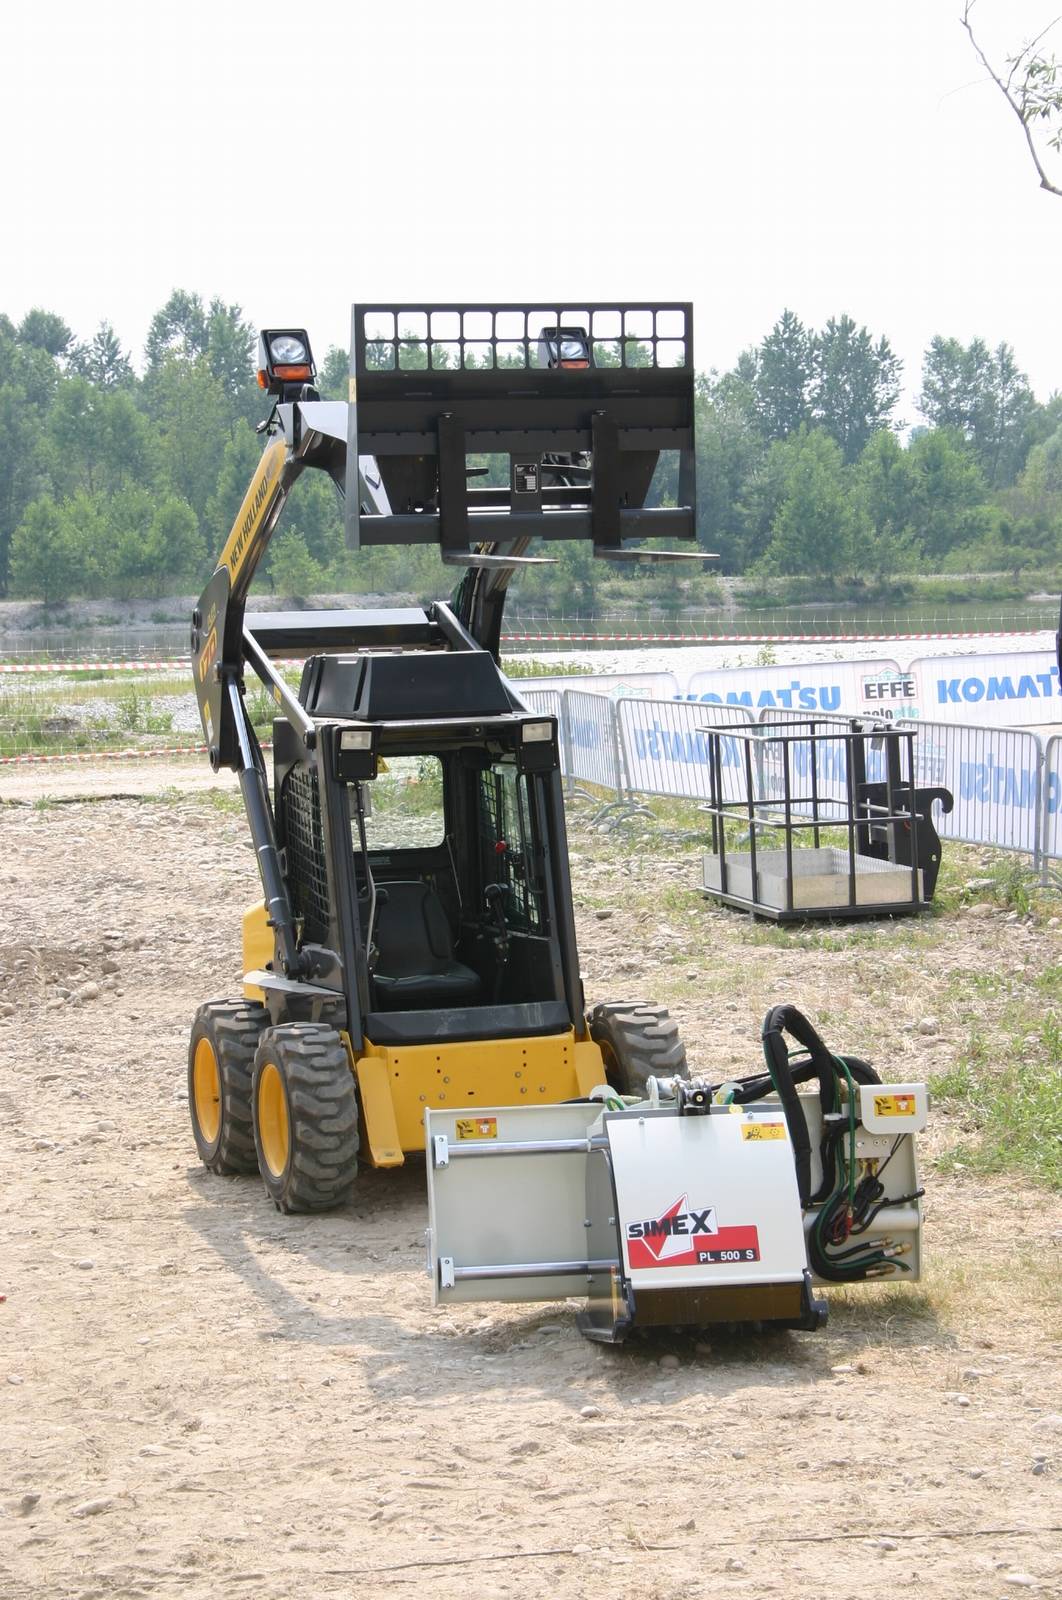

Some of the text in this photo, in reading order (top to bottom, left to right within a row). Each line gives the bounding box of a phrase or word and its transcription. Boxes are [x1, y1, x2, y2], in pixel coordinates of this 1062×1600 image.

[230, 476, 268, 570] NEW HOLLAND
[673, 681, 841, 711] MATSU
[864, 681, 915, 699] EFFE
[937, 666, 1062, 704] KOMAT
[628, 1209, 713, 1238] SIMEX
[699, 1250, 754, 1262] PL 500 S
